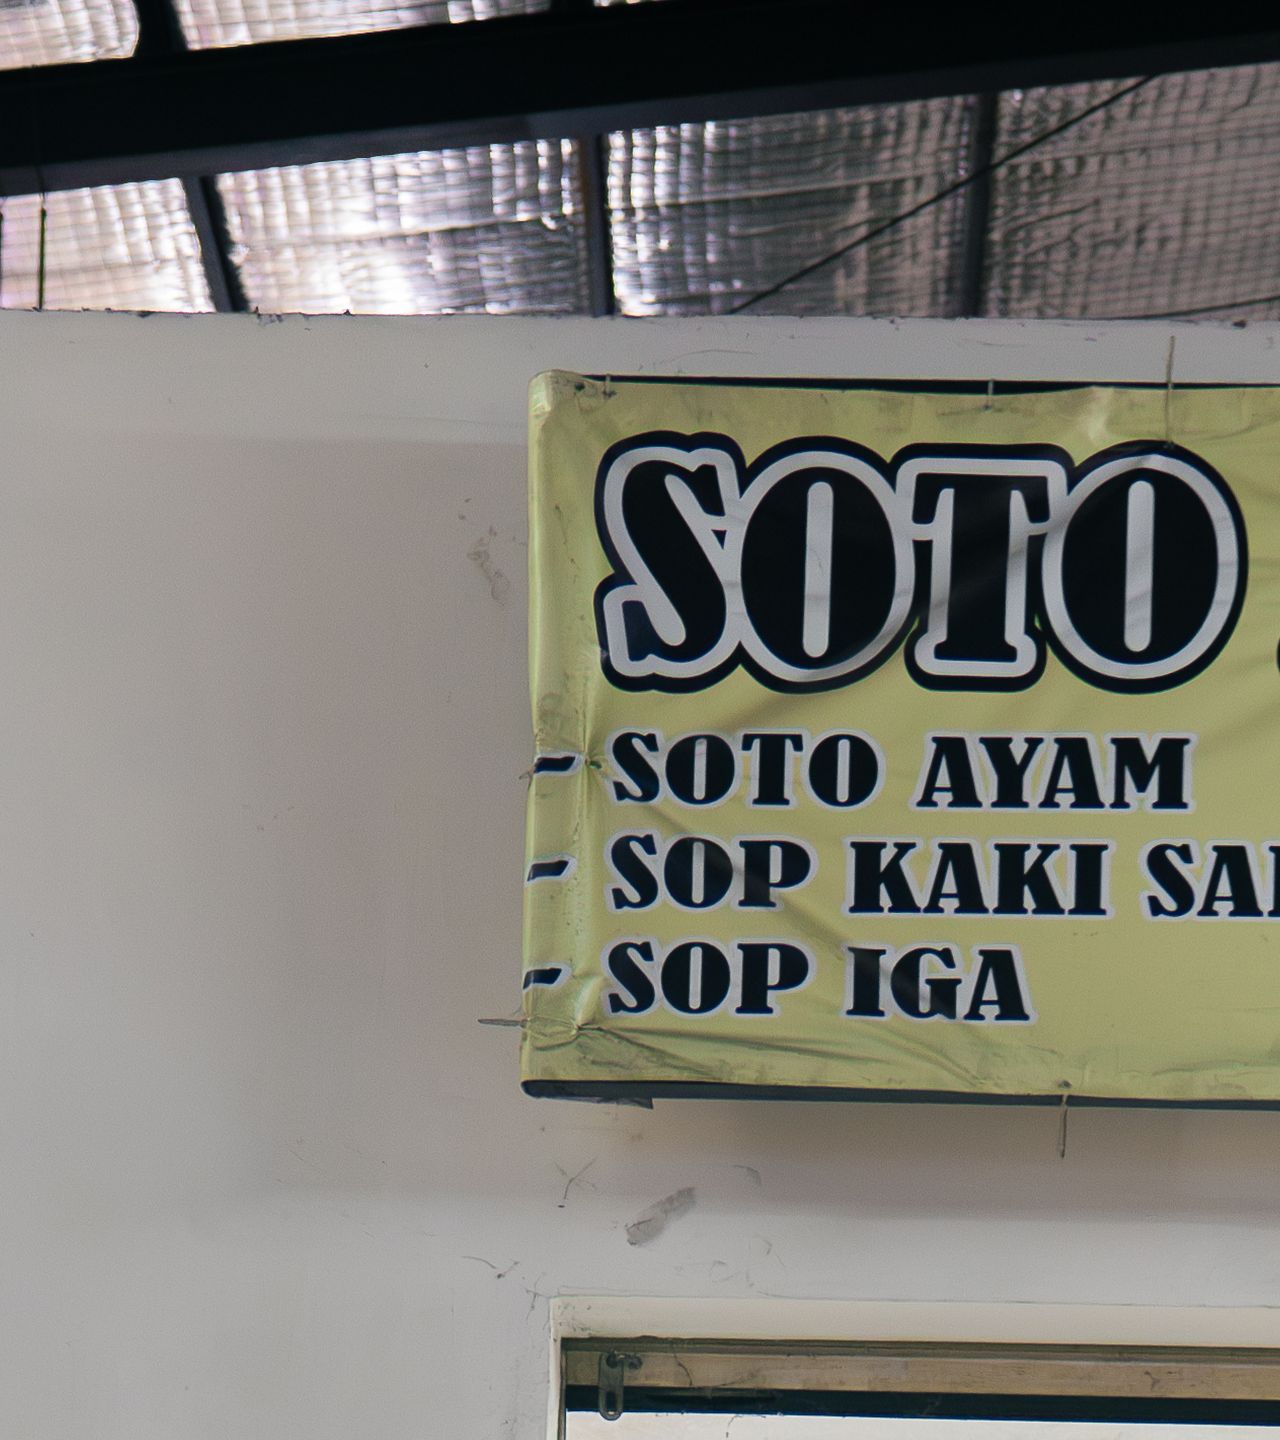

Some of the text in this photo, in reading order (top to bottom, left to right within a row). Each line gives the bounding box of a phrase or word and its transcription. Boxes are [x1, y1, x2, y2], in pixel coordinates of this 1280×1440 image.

[594, 430, 1249, 694] SOTO
[612, 732, 879, 807] SOTO
[917, 736, 1190, 810] AYAM
[611, 834, 811, 910] SOP
[848, 841, 1109, 916] KAKI
[608, 941, 809, 1015] SOP
[846, 946, 1030, 1021] IGA
